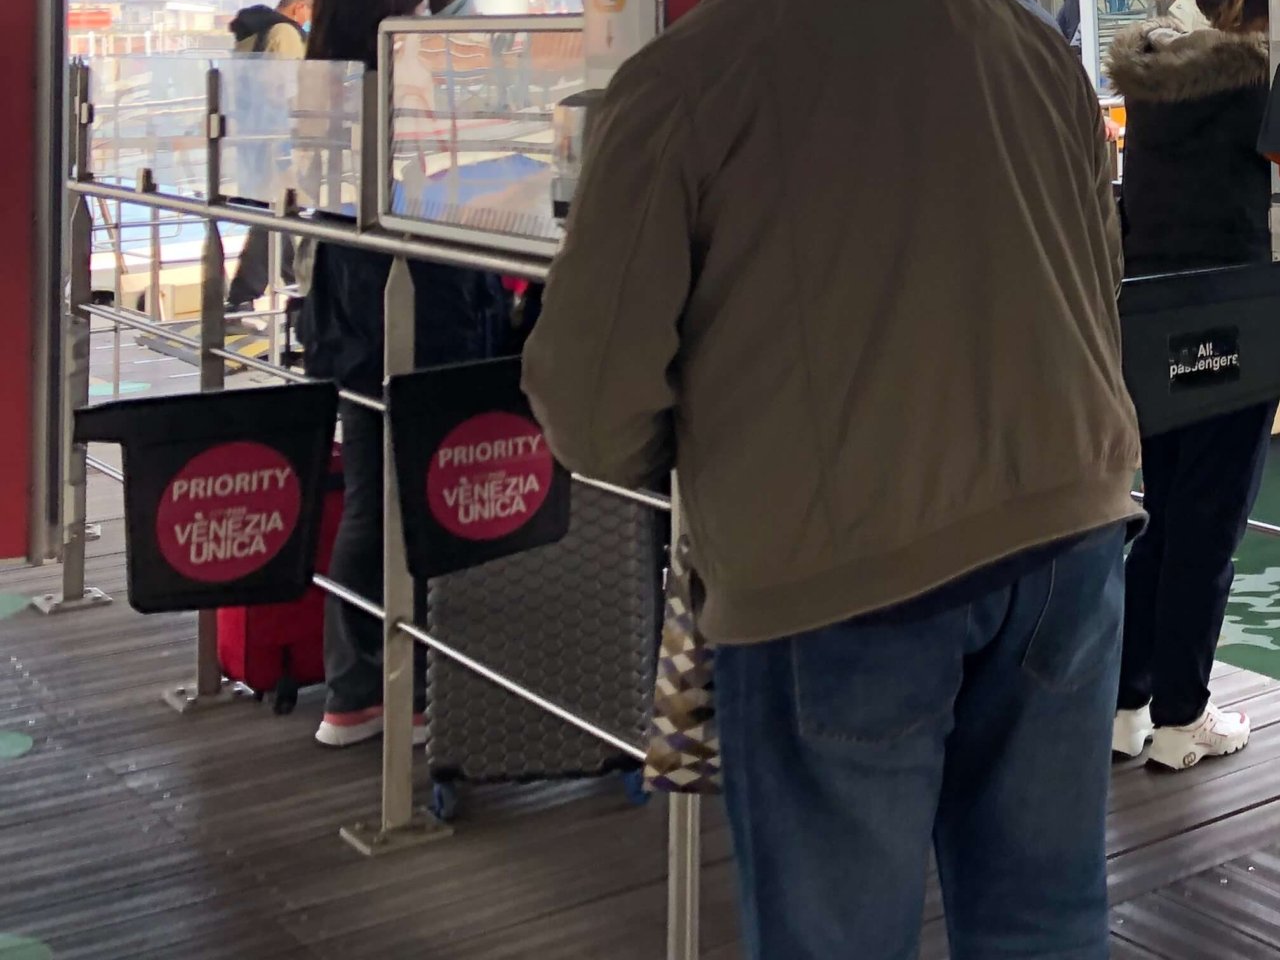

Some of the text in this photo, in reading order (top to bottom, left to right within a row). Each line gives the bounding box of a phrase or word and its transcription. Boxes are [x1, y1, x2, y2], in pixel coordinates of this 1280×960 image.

[1198, 342, 1213, 358] All
[438, 433, 542, 469] PRIORITY
[172, 466, 292, 503] PRIORITY
[458, 495, 527, 524] UNICA
[190, 534, 267, 565] UNICA
